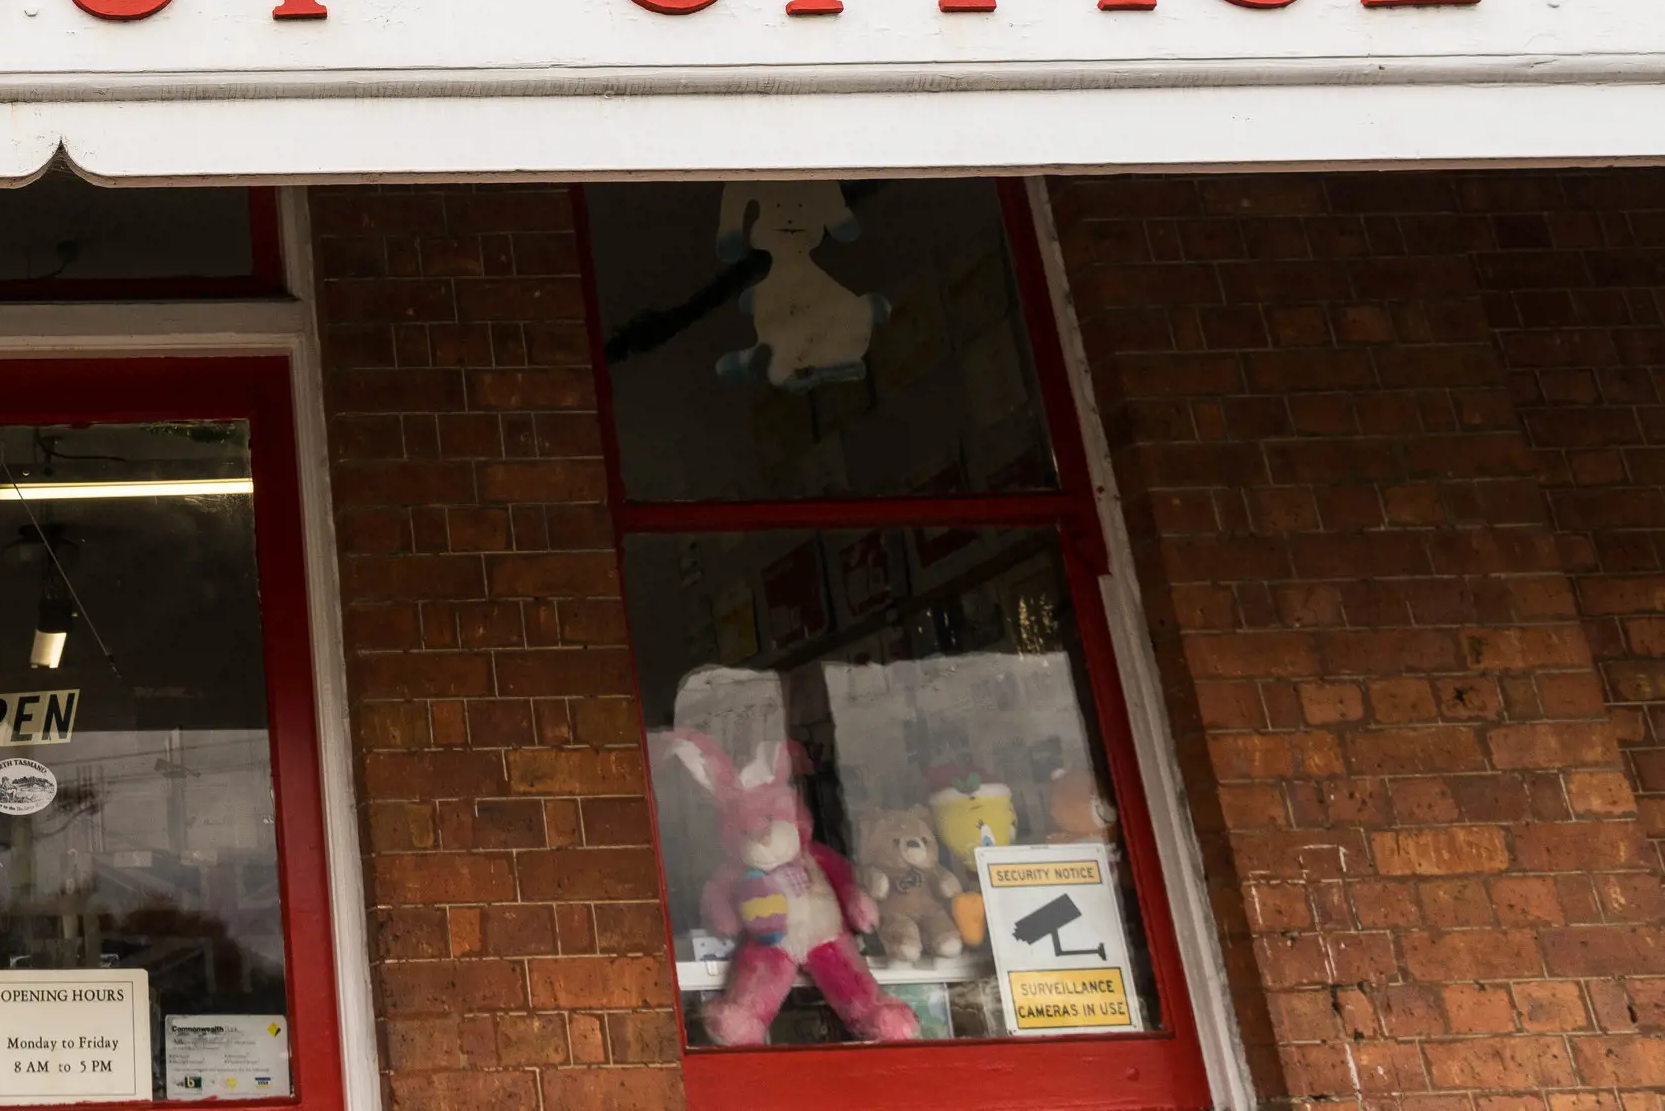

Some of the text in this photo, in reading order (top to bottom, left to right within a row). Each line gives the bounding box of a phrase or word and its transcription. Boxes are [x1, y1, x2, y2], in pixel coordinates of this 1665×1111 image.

[996, 867, 1095, 882] SECURITY NOTICE
[0, 989, 125, 1002] OPENING HOURS
[1020, 980, 1115, 996] SURVEILLANCE
[1018, 1001, 1126, 1018] CAMERAS IN USE
[7, 1036, 119, 1051] Monday to Friday
[14, 1060, 112, 1073] 8 AM to 5 PM
